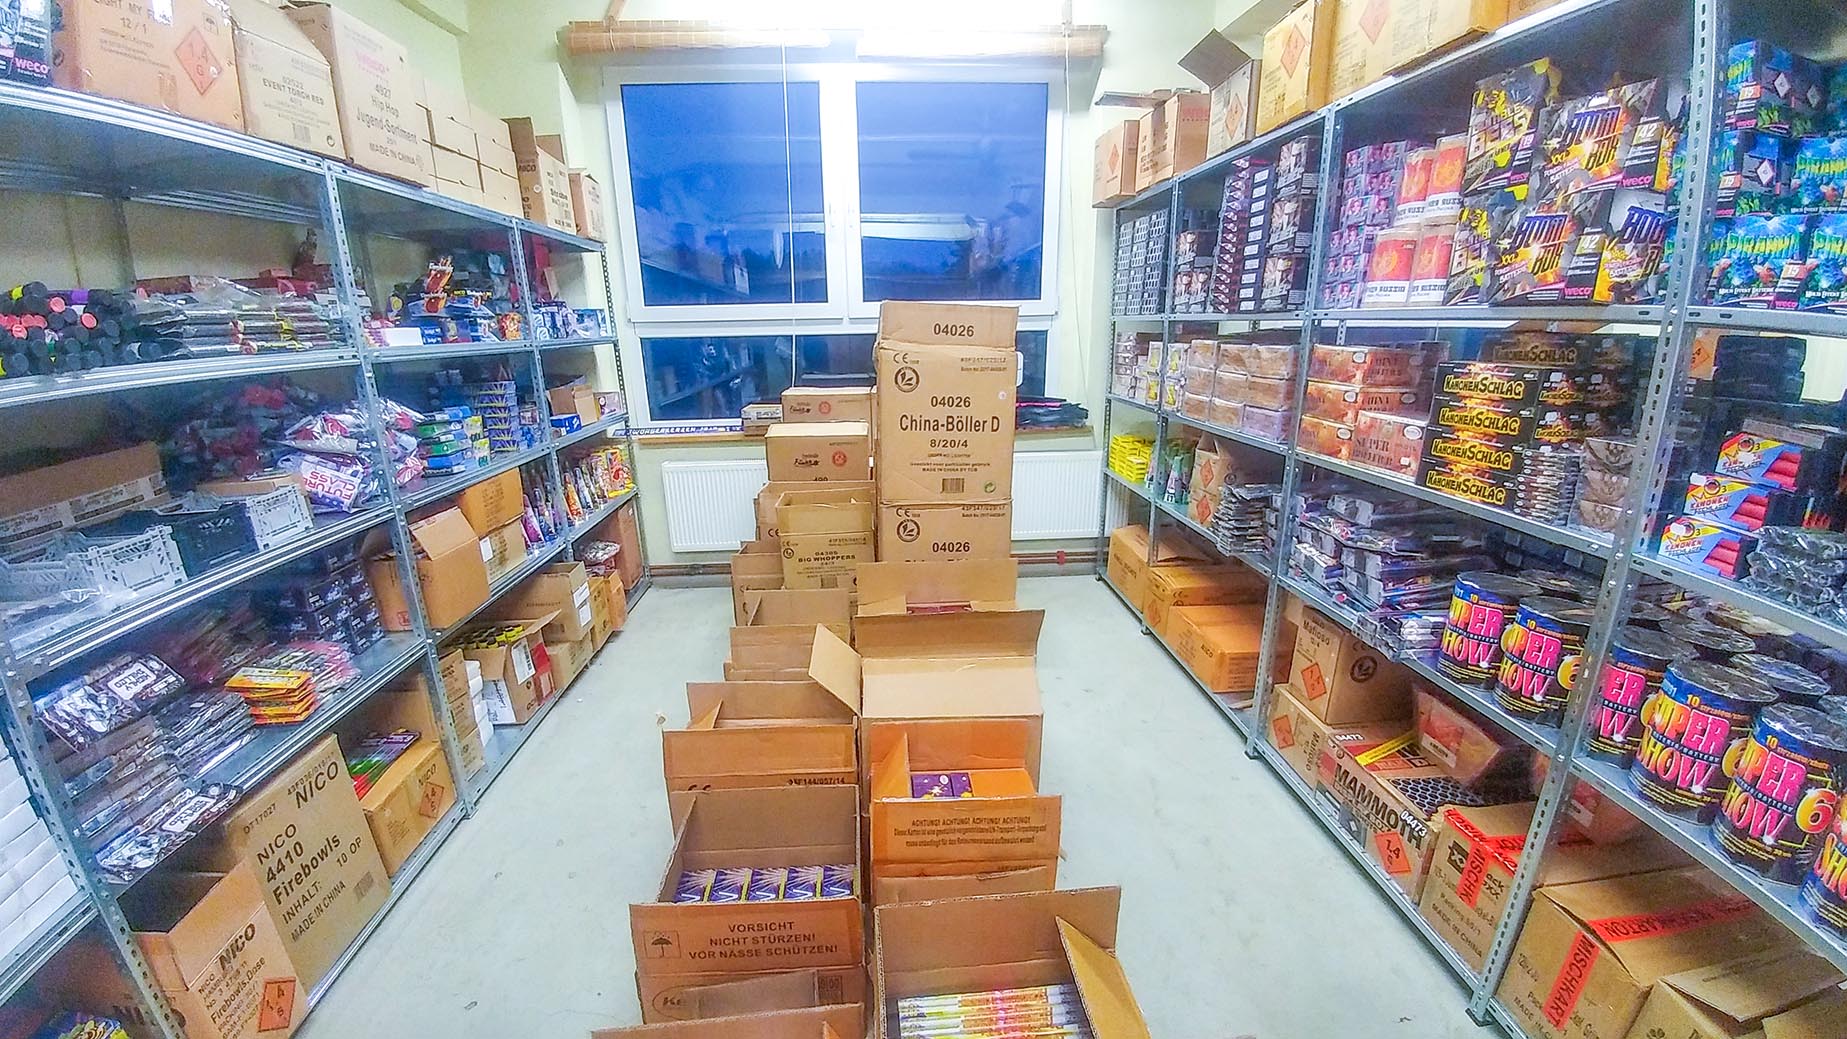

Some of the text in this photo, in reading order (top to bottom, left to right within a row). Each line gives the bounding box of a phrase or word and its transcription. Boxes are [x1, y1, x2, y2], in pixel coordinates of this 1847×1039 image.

[14, 58, 49, 74] weco
[262, 78, 286, 93] EVENT
[1640, 122, 1658, 138] 42
[1622, 175, 1654, 187] weco
[1583, 234, 1600, 249] 42
[1563, 286, 1594, 296] weco
[933, 323, 975, 338] 04026
[930, 395, 971, 408] 04026
[899, 414, 1000, 433] China-Böller D
[929, 439, 969, 449] 8/20/4
[309, 471, 356, 492] CLASS
[932, 541, 971, 553] 04026
[813, 554, 856, 563] WHOPPERS
[1470, 593, 1479, 603] 10
[1449, 597, 1505, 639] UPER
[1526, 618, 1536, 630] 10
[1441, 628, 1498, 666] HOW
[1507, 622, 1562, 672] UPER
[1500, 659, 1550, 698] HOW
[1687, 694, 1700, 706] 10
[1656, 692, 1730, 757] UPER
[1766, 734, 1779, 749] 10
[1739, 737, 1807, 807] UPER
[294, 760, 339, 810] NICO
[1722, 779, 1793, 839] HOW
[1796, 788, 1838, 834] 6
[911, 816, 1031, 827] ACHTUNG! ACHTUNG! ACHTUNG! ACHTUNG!
[1400, 810, 1428, 837] 04473
[256, 822, 298, 866] NICO
[265, 840, 305, 885] 4410
[271, 834, 342, 906] Firebowls
[281, 836, 363, 925] INHALT: 10 OP
[290, 880, 347, 943] MADE IN CHINA
[728, 921, 796, 933] VORSICHT
[217, 922, 256, 972] NICO
[709, 933, 816, 947] NICHT STÜRZEN!
[689, 950, 717, 960] VOR
[766, 944, 838, 957] SCHÜTZEN!
[198, 973, 216, 995] NICO
